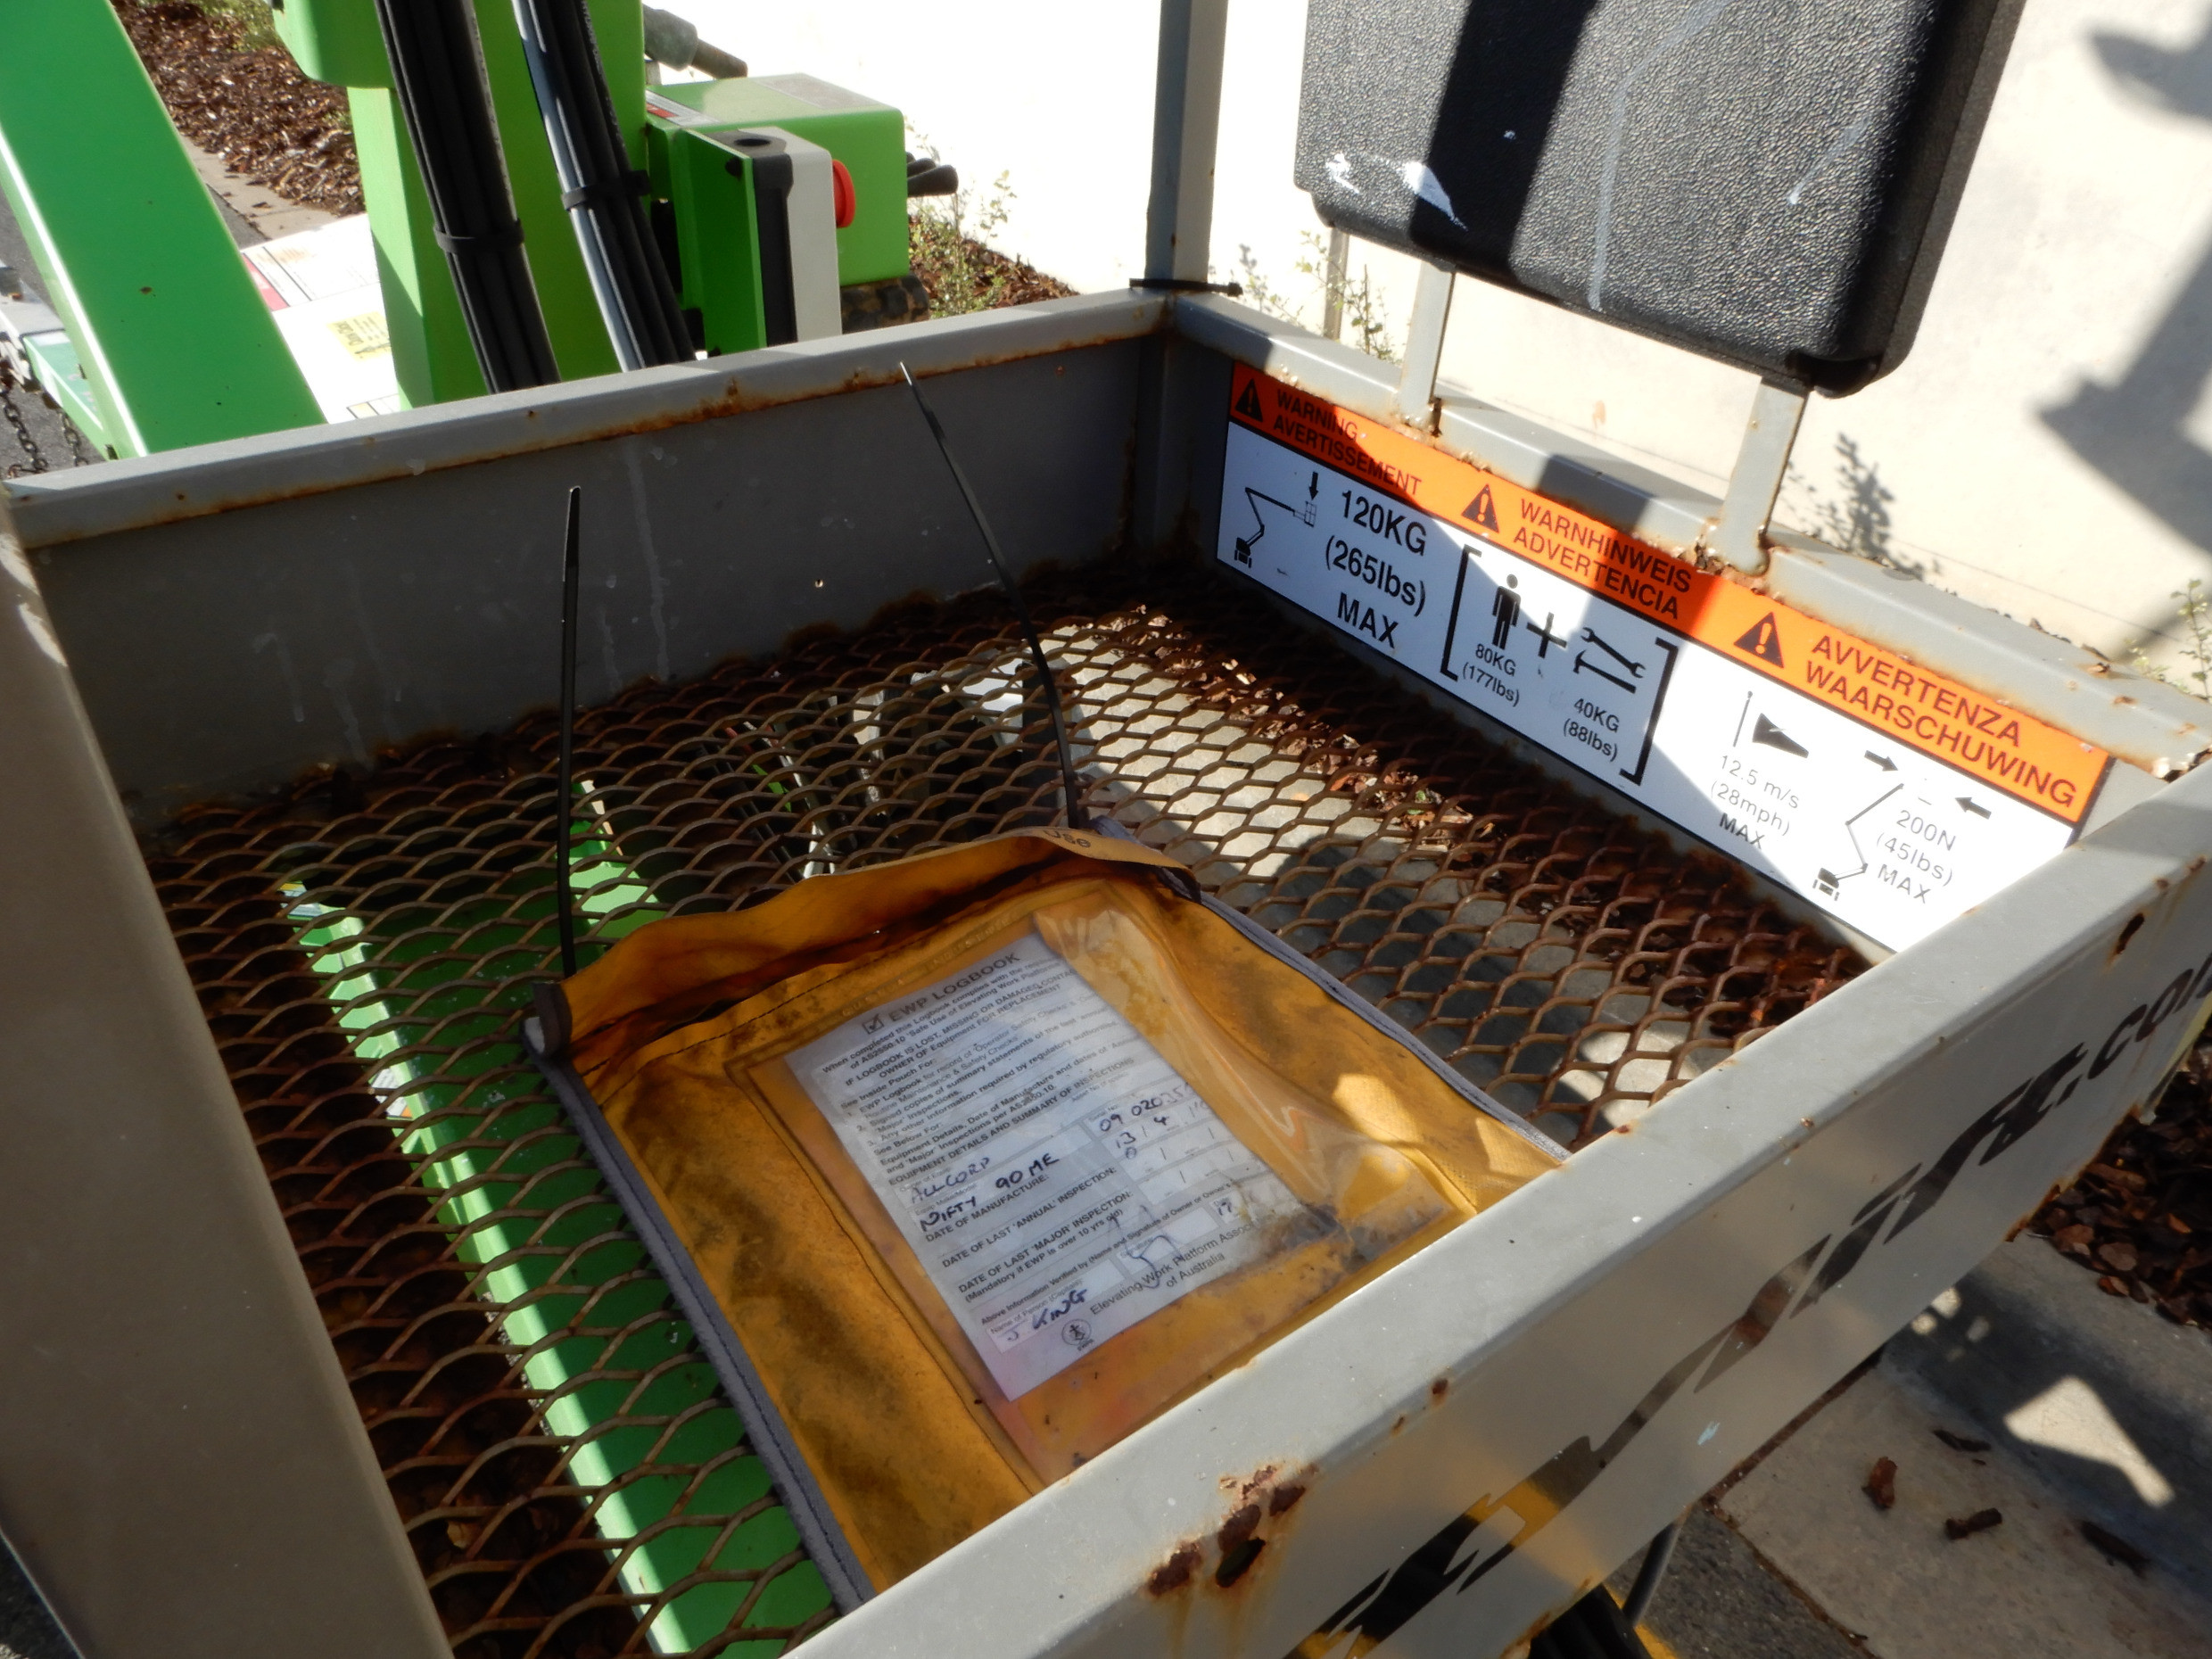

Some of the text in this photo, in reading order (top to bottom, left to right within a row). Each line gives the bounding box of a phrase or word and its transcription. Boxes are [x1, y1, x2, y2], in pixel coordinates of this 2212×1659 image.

[1275, 387, 1358, 443] WARNING
[1273, 410, 1423, 499] AVERTISSEMENT
[1338, 485, 1429, 558] 120KG
[1518, 497, 1693, 596] WARNHINWEIS
[1323, 532, 1428, 621] (265lbs)
[1513, 523, 1682, 621] ADVERTENCIA
[1336, 590, 1399, 650] MAX
[1461, 660, 1521, 709] (177lbs)
[1473, 641, 1517, 679] 80KG
[1810, 631, 2028, 749] AVVERTENZA
[1561, 716, 1619, 764] (88lbs)
[1572, 694, 1621, 735] 40KG
[1801, 658, 2082, 811] WAARSCHUWING
[1708, 777, 1794, 838] (28mph)
[1719, 753, 1803, 811] 12.5 m/s
[1718, 811, 1766, 852] MAX
[1872, 829, 1957, 889] (45lbs)
[1895, 806, 1959, 853] 200N
[1875, 863, 1932, 905] MAX
[848, 1060, 861, 1069] of
[929, 1013, 947, 1026] Use
[945, 1007, 958, 1016] of
[956, 986, 998, 1011] Elevating
[996, 976, 1019, 990] Work
[887, 995, 931, 1022] EWP
[929, 951, 1020, 1001] LOGBOOK
[821, 1056, 849, 1074] When
[847, 1030, 896, 1060] completed
[894, 1021, 912, 1034] this
[912, 1001, 953, 1025] Logbook
[844, 1077, 856, 1086] IF
[854, 1052, 904, 1080] LOGBOOK
[903, 1045, 915, 1055] IS
[939, 1010, 981, 1034] MISSING
[978, 1002, 995, 1013] OR
[877, 1055, 915, 1078] OWNER
[913, 1048, 929, 1059] OF
[928, 1022, 978, 1051] Equipment
[974, 1011, 997, 1026] FOR
[995, 979, 1063, 1018] REPLACEMENT
[858, 1083, 887, 1101] Inside
[887, 1067, 918, 1086] Pouch
[868, 1107, 903, 1129] Signed
[902, 1092, 935, 1112] copies
[933, 1085, 945, 1095] of
[944, 1064, 987, 1089] summary
[984, 1036, 1036, 1067] statements
[1033, 1030, 1045, 1039] of
[879, 1127, 900, 1143] Any
[900, 1116, 926, 1133] other
[924, 1089, 978, 1120] information
[976, 1069, 1017, 1093] required
[1014, 1061, 1029, 1072] by
[1026, 1037, 1074, 1065] regulatory
[879, 1136, 931, 1168] Equipment
[965, 1109, 989, 1125] Date
[987, 1102, 1001, 1113] of
[998, 1073, 1056, 1106] Manufacture
[1052, 1062, 1073, 1076] and
[1071, 1050, 1098, 1067] dates
[880, 1077, 923, 1102] Logbook
[921, 1069, 936, 1080] for
[934, 1054, 963, 1073] record
[962, 1049, 974, 1059] of
[897, 1072, 953, 1103] Maintenance
[951, 1067, 961, 1076] &
[959, 1052, 988, 1070] Safety
[872, 1143, 892, 1157] See
[892, 1129, 923, 1149] Below
[885, 1161, 904, 1175] and
[937, 1118, 993, 1151] Inspections
[991, 1110, 1009, 1123] per
[887, 1152, 946, 1189] EQUIPMENT
[946, 1132, 991, 1159] DETAILS
[987, 1120, 1011, 1136] AND
[1009, 1094, 1061, 1125] SUMMARY
[1056, 1085, 1075, 1098] OF
[1071, 1054, 1135, 1091] INSPECTIONS
[924, 1223, 954, 1243] DATE
[953, 1215, 971, 1228] OF
[969, 1172, 1051, 1219] MANUFACTURE:
[941, 1249, 970, 1268] DATE
[969, 1240, 986, 1253] OF
[984, 1226, 1013, 1245] LAST
[1054, 1165, 1118, 1203] INSPECTION:
[956, 1272, 987, 1293] DATE
[986, 1263, 1004, 1277] OF
[1002, 1248, 1032, 1268] LAST
[1069, 1188, 1135, 1228] INSPECTION:
[963, 1269, 1018, 1303] (Mandatory
[1015, 1264, 1026, 1274] if
[1022, 1251, 1048, 1269] EWP
[1045, 1246, 1057, 1256] is
[1055, 1234, 1078, 1250] over
[1077, 1226, 1091, 1237] 10
[1089, 1218, 1107, 1232] yrs
[979, 1307, 1007, 1325] Above
[1004, 1283, 1051, 1311] Information
[1048, 1266, 1079, 1286] Verified
[1077, 1260, 1089, 1270] by
[1160, 1212, 1172, 1222] of
[1168, 1200, 1194, 1217] Owner
[1192, 1195, 1203, 1204] or
[1087, 1279, 1144, 1316] Elevating
[1140, 1261, 1174, 1284] Work
[1171, 1236, 1219, 1267] Platform
[1163, 1250, 1226, 1288] of Australia
